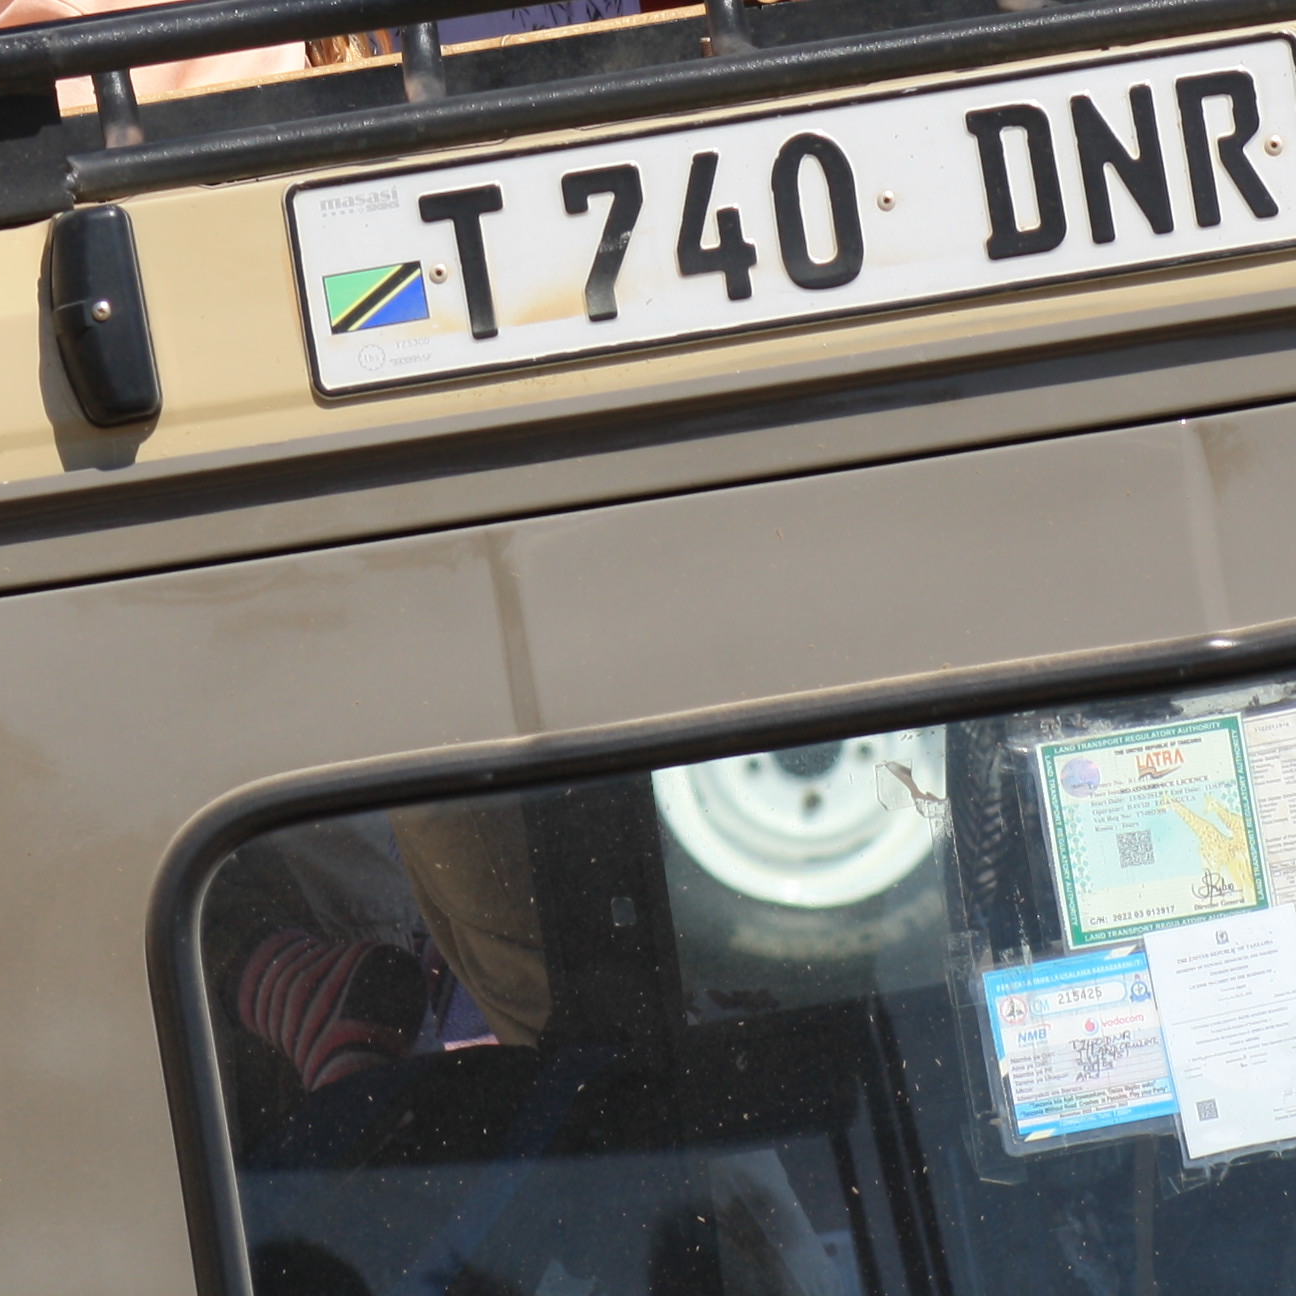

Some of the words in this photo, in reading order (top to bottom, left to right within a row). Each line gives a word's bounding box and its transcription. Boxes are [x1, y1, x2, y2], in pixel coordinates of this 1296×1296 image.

[320, 186, 399, 211] masasi
[418, 182, 503, 339] T
[560, 132, 865, 322] 740
[964, 69, 1279, 260] DNR
[1053, 744, 1074, 754] LAND
[1077, 736, 1124, 750] TRANSPORT
[1124, 728, 1176, 743] REGULATORY
[1176, 721, 1221, 734] AUTHORITY
[1231, 728, 1244, 774] AUTHORITY
[1044, 754, 1053, 777] LAND
[1135, 748, 1184, 770] LATRA
[1048, 778, 1061, 825] TRANSPORT
[1238, 774, 1253, 827] REGULATORY
[1056, 827, 1070, 879] REGULATORY
[1247, 828, 1260, 876] TRANSPORT
[1064, 880, 1077, 926] AUTHORITY
[1255, 877, 1265, 900] LAND
[1084, 931, 1107, 941] LAND
[1107, 923, 1154, 937] TRANSPORT
[1056, 986, 1103, 1004] 215425
[1017, 1028, 1047, 1042] NMB
[1100, 1013, 1144, 1027] vodacom
